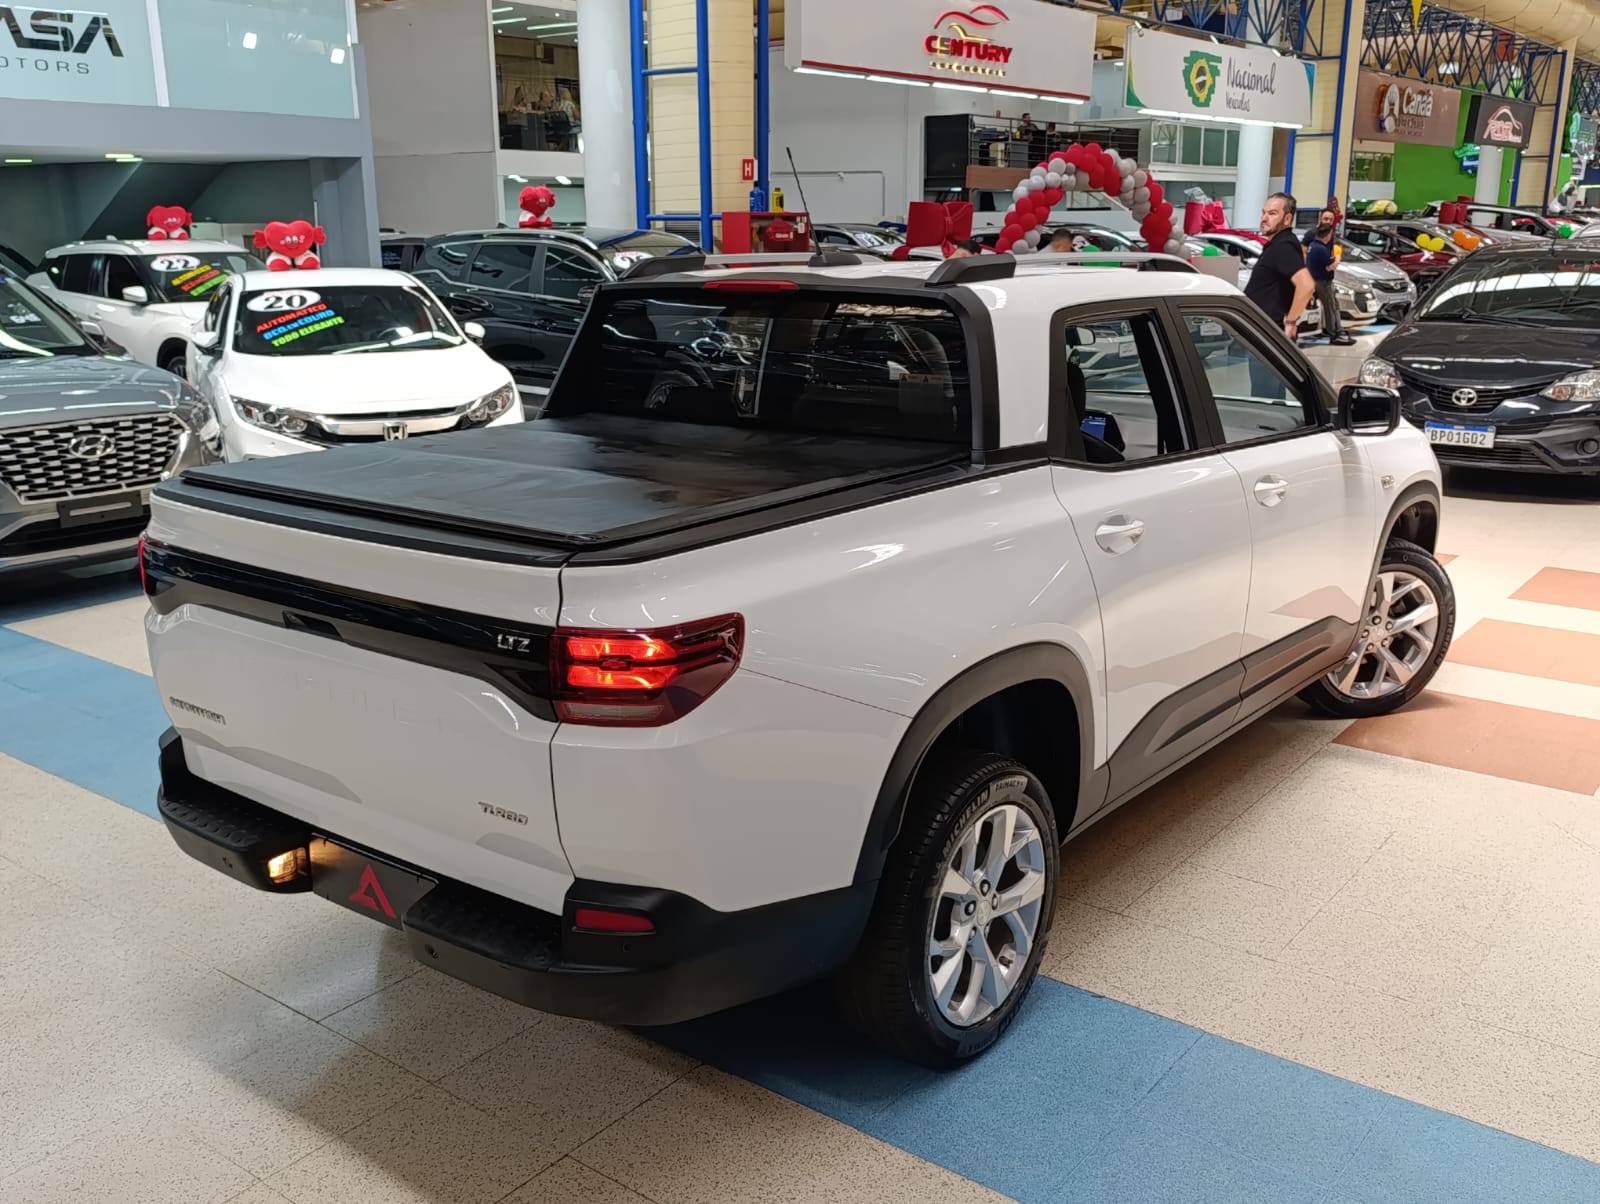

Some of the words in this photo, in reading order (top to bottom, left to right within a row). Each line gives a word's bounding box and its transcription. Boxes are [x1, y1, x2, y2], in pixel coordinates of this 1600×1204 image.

[924, 35, 1013, 63] CENTURY
[1227, 56, 1276, 95] Nacional
[744, 162, 752, 177] H
[159, 258, 196, 270] 22
[264, 294, 308, 310] 20
[271, 330, 300, 347] TODO
[497, 633, 531, 653] LTZ
[478, 801, 529, 825] TURBO
[942, 788, 989, 858] MICHELIN
